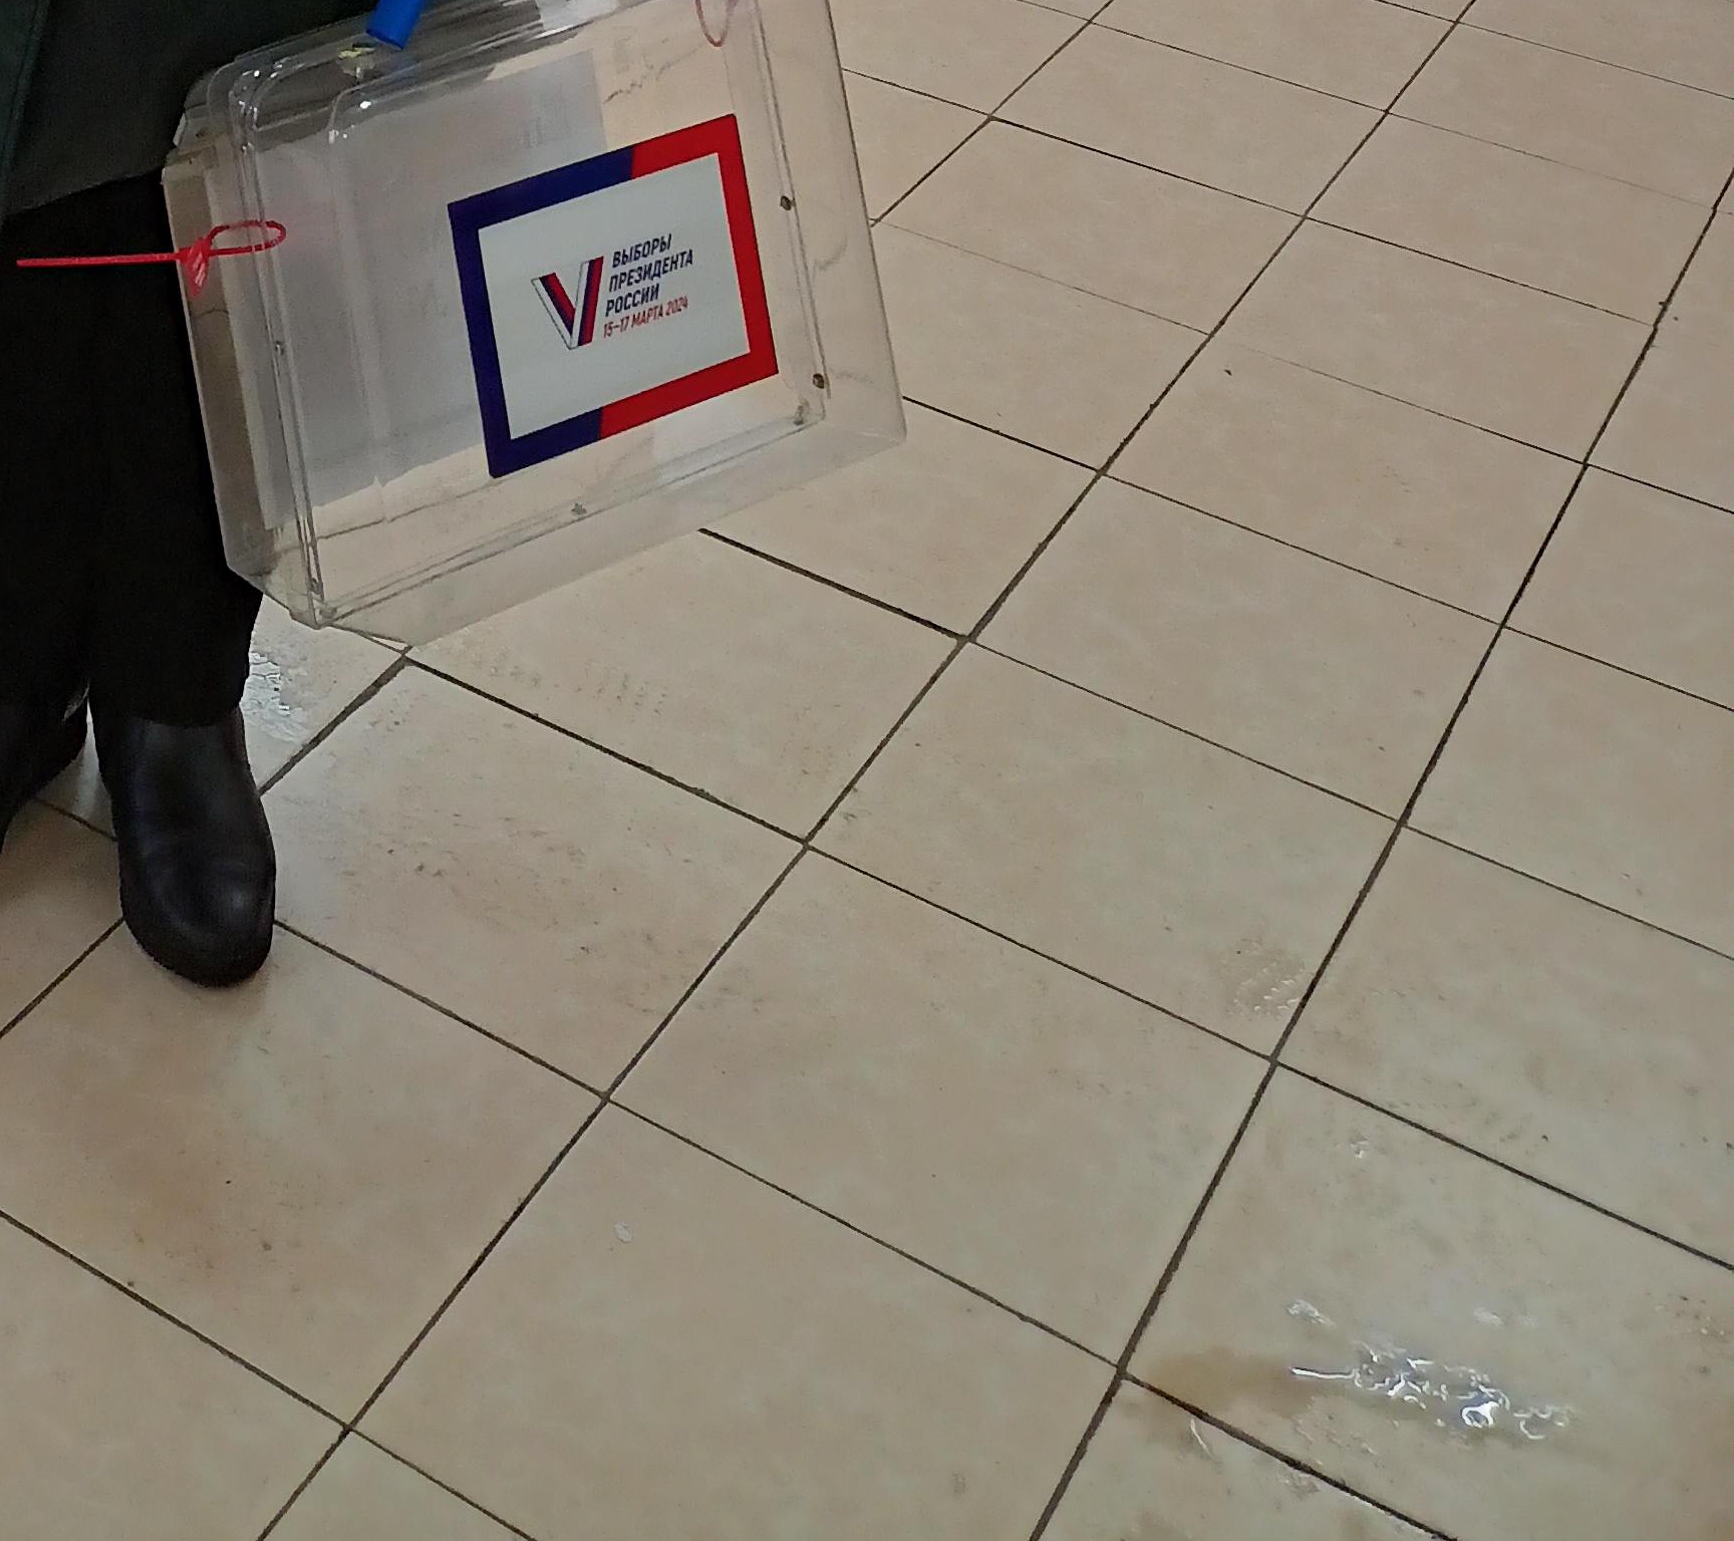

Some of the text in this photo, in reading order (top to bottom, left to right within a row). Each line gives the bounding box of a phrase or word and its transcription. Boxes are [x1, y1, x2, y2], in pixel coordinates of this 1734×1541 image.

[611, 233, 673, 269] ВЫБОРЫ
[608, 248, 694, 293] ПРЕЗИДЕНТА
[604, 283, 661, 318] РОССИИ
[630, 304, 664, 329] МАРТА
[664, 295, 690, 318] 2024
